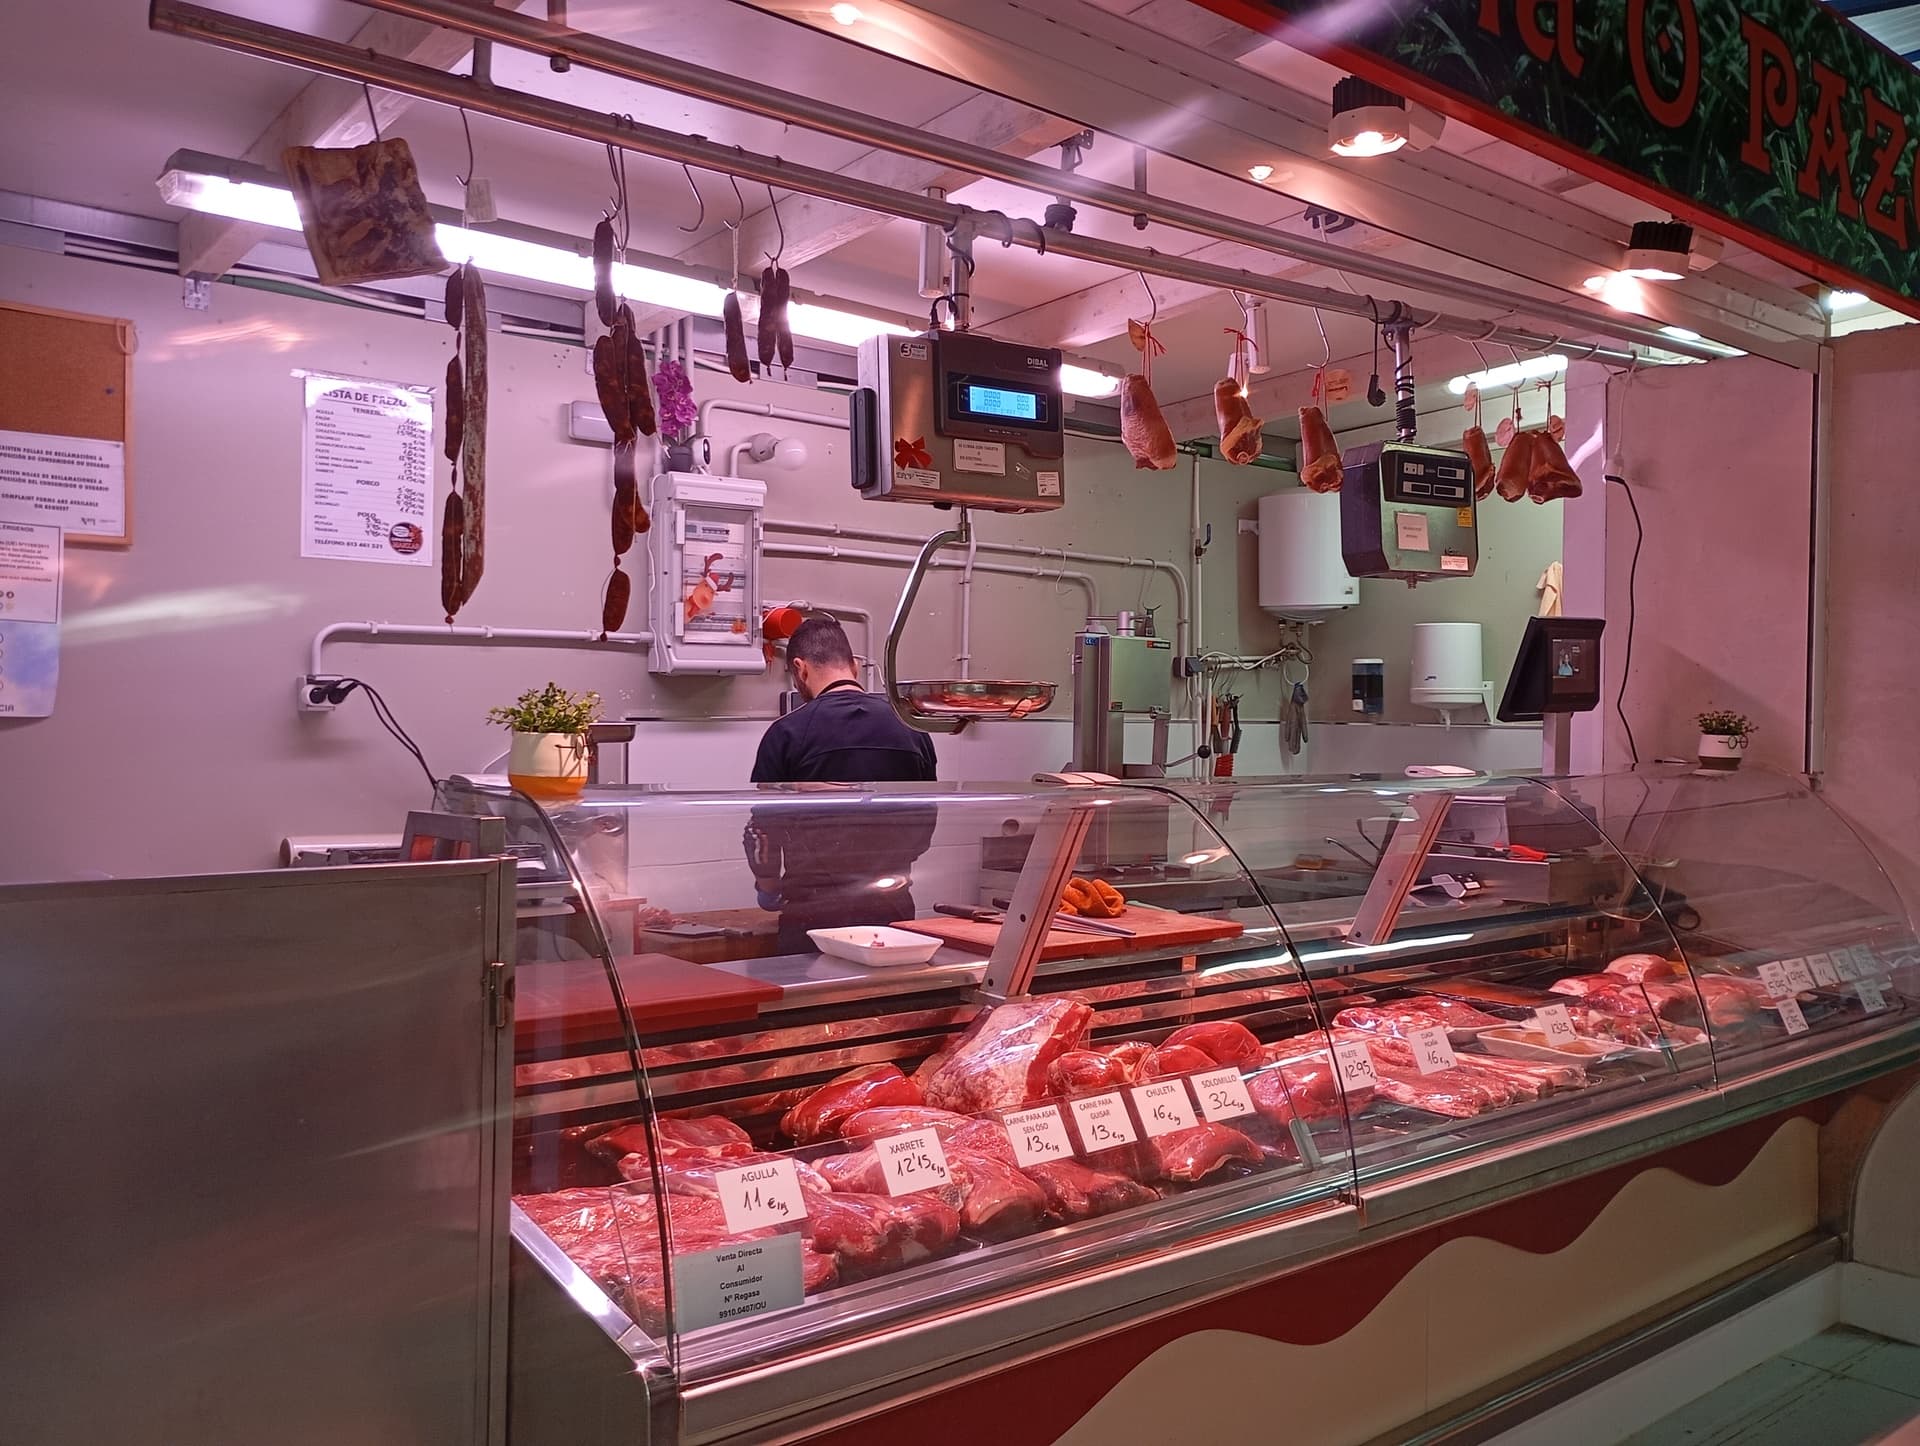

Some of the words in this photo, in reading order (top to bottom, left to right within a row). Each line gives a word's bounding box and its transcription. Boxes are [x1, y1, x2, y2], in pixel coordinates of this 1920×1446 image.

[1741, 15, 1920, 250] PAZ
[1027, 357, 1049, 368] DIBAL
[355, 392, 369, 403] DE
[372, 394, 410, 407] PREZO
[352, 407, 387, 417] TENREI
[1201, 1074, 1237, 1089] SOLOMILLO
[1146, 1085, 1176, 1098] CHULETA
[1079, 1101, 1098, 1111] CARNE
[1098, 1098, 1113, 1107] PARA
[1005, 1116, 1026, 1126] CARNE
[1026, 1113, 1042, 1123] PARA
[1041, 1109, 1057, 1119] ASAR
[1090, 1109, 1111, 1120] GUISAR
[1022, 1126, 1035, 1134] SEN
[889, 1138, 925, 1155] XARRETE
[741, 1167, 779, 1184] AGULLA
[716, 1253, 737, 1262] Venta
[738, 1247, 763, 1258] Directa
[737, 1264, 745, 1273] Al
[720, 1275, 763, 1290] Consumidor
[734, 1290, 760, 1301] Regasa
[719, 1301, 767, 1318] 9910.0407/OU
